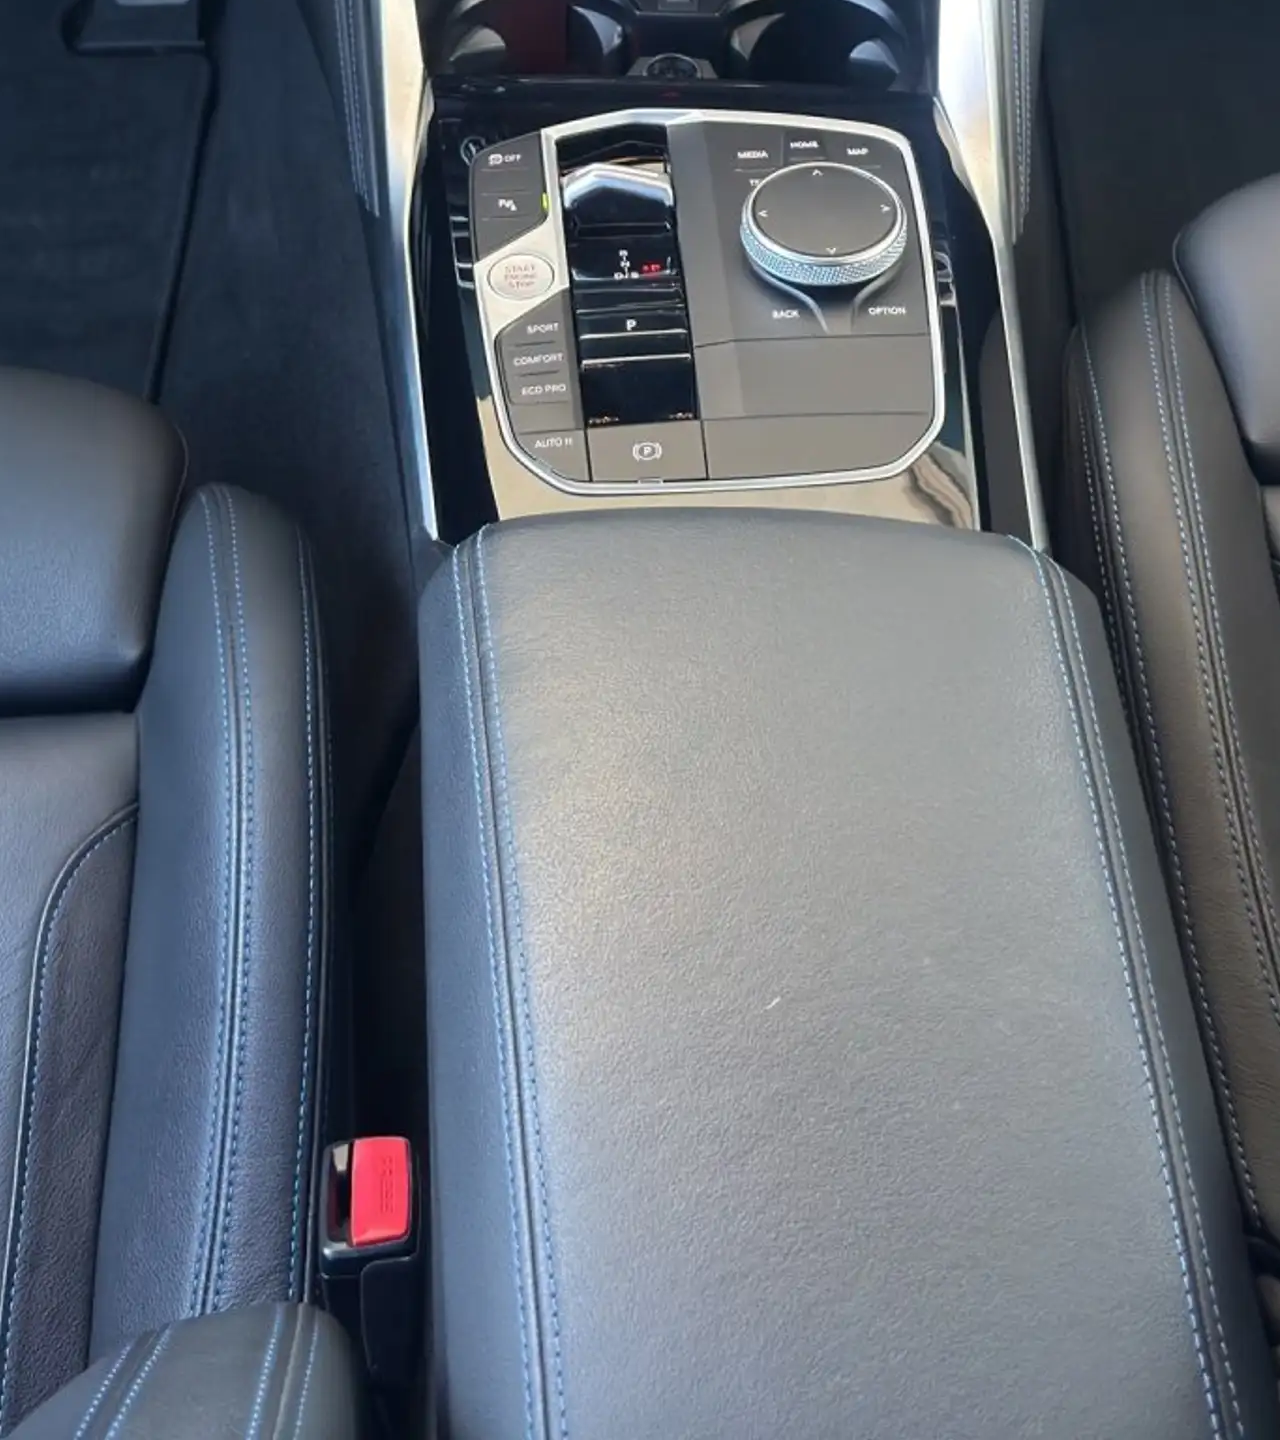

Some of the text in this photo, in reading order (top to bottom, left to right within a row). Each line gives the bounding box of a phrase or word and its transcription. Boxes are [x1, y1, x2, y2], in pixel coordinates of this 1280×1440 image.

[790, 140, 819, 149] HOME
[737, 149, 768, 159] MEDIA
[846, 147, 869, 156] MAP
[504, 153, 522, 162] OFF
[772, 310, 800, 319] BACK
[868, 307, 906, 317] OPTION
[526, 323, 559, 334] SPORT
[626, 319, 637, 331] P
[513, 353, 564, 366] COMFORT
[545, 384, 566, 394] PRO
[534, 439, 563, 448] AUTO
